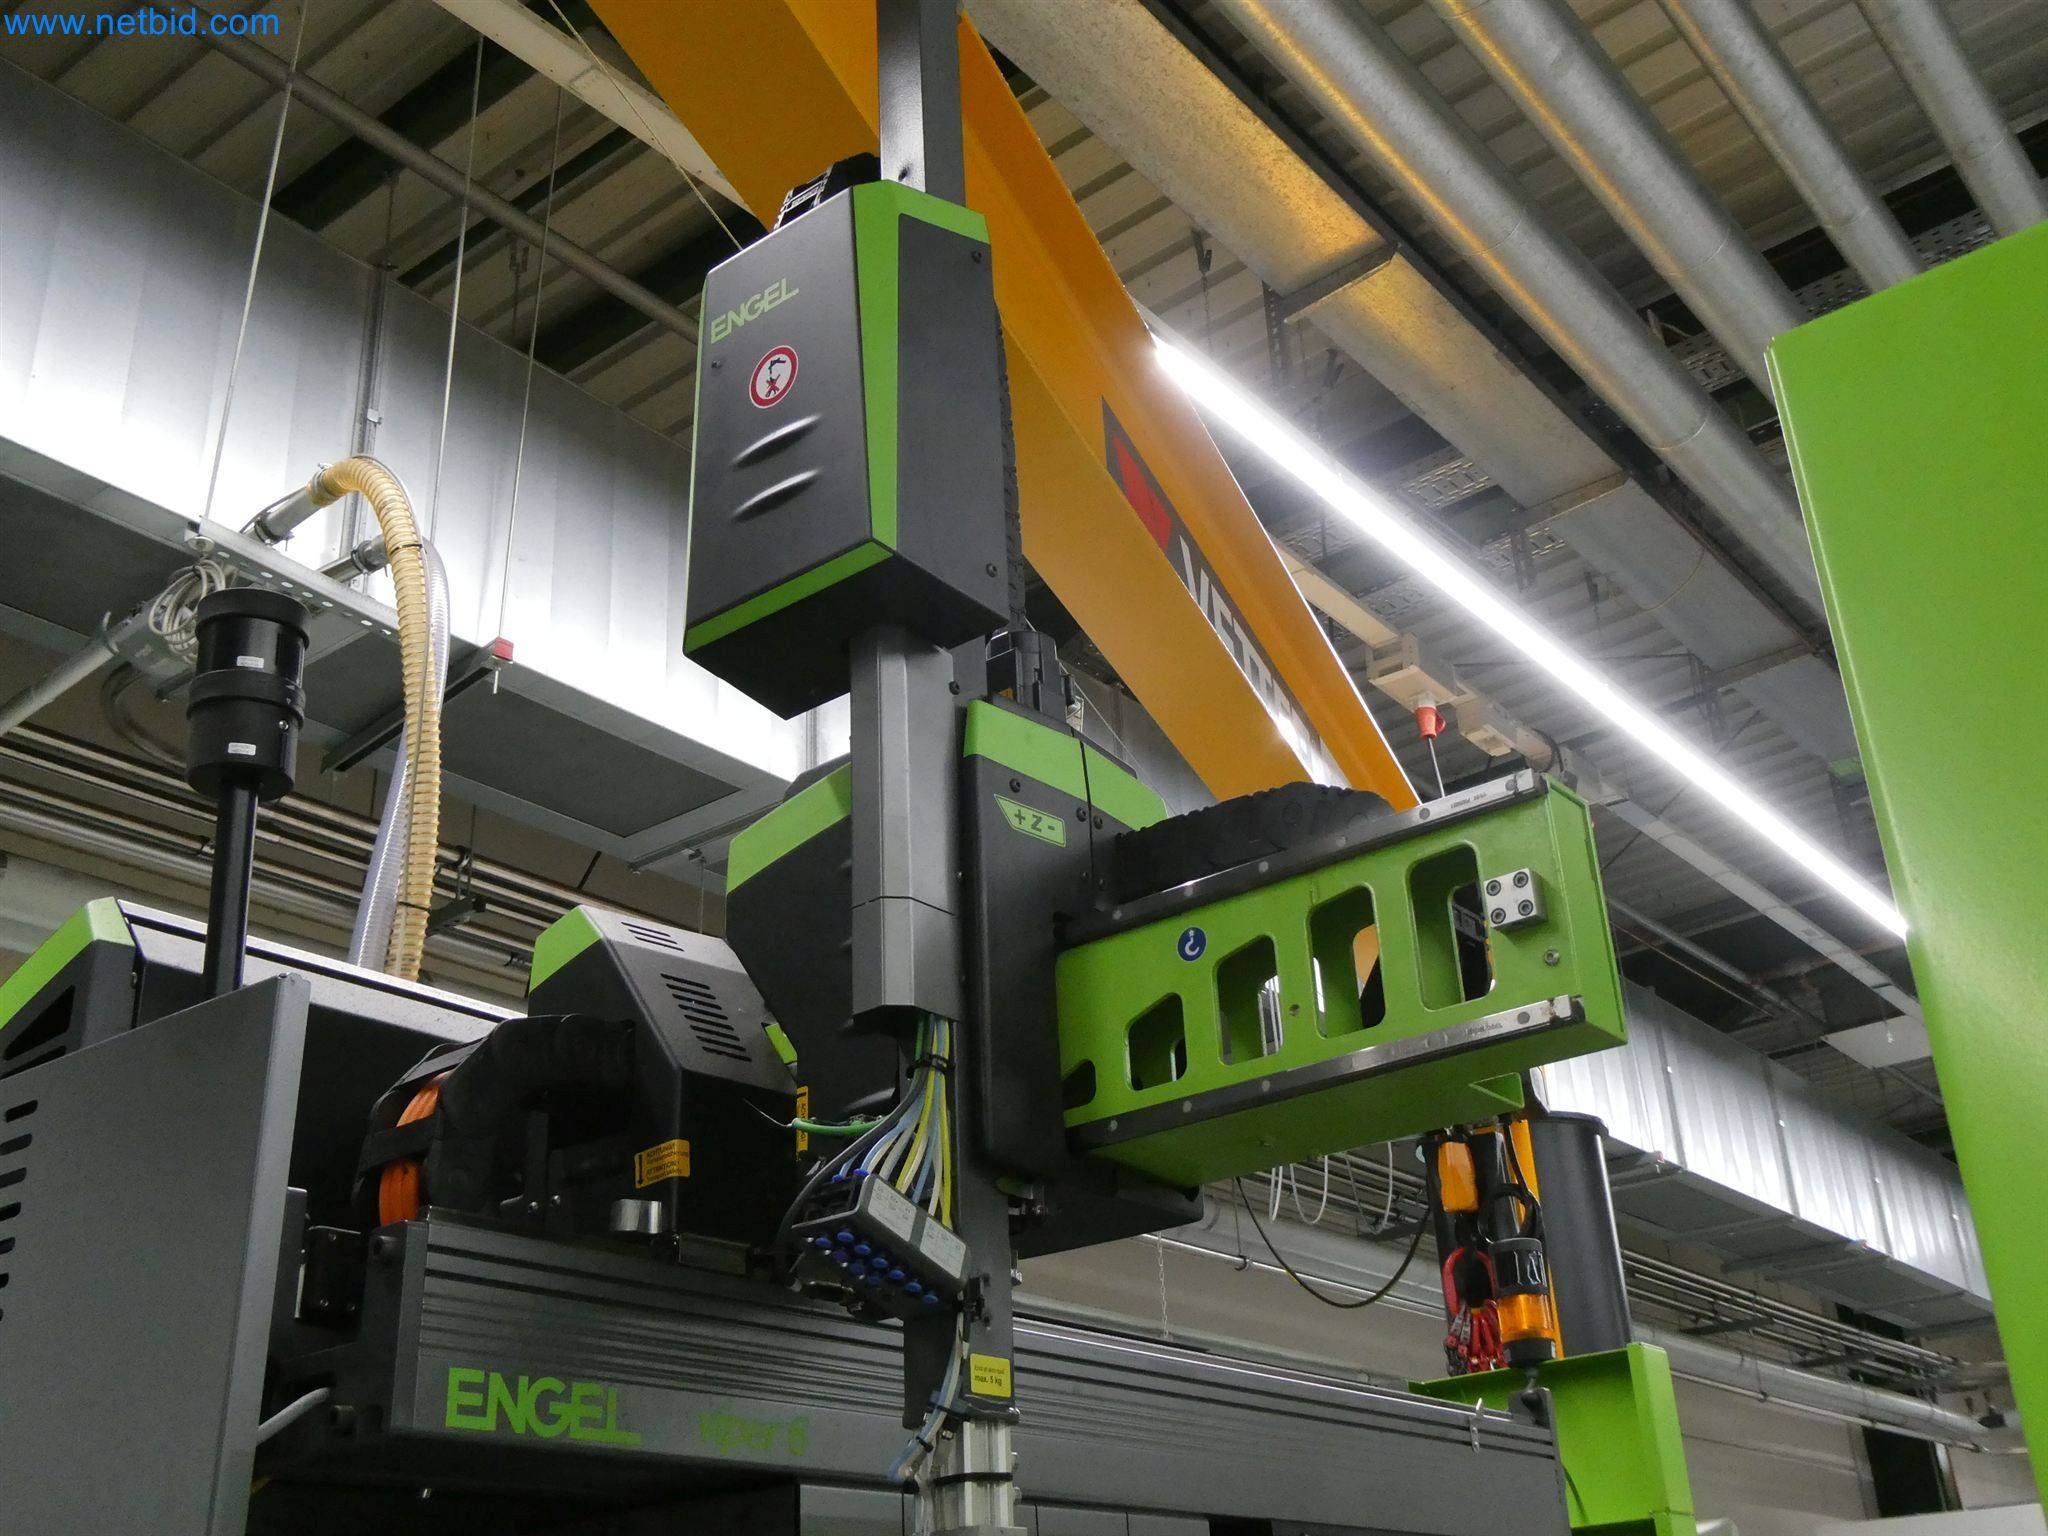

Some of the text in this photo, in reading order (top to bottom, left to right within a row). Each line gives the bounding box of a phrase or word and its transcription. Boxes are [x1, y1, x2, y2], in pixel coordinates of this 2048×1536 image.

[710, 278, 800, 344] ENGEL
[445, 1366, 641, 1446] ENGEL
[788, 1415, 809, 1457] 6
